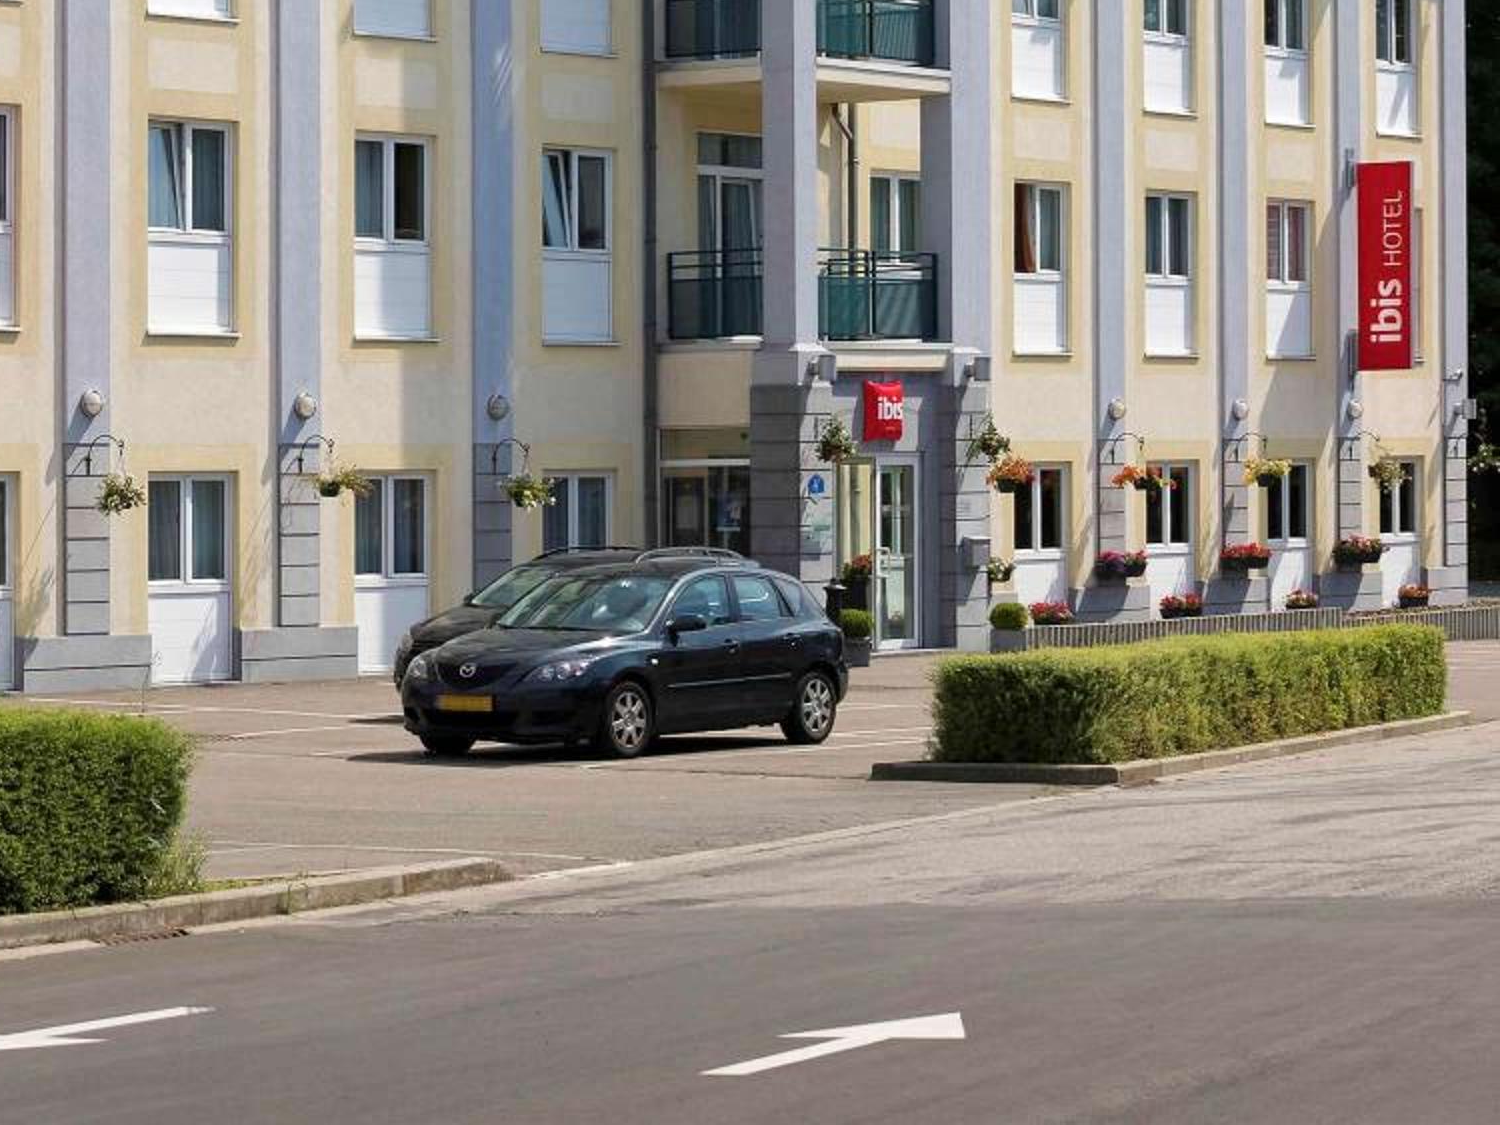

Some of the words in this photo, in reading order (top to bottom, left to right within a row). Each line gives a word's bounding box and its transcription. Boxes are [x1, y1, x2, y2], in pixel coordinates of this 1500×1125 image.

[1383, 190, 1402, 266] HOTEL
[1371, 278, 1402, 343] ibis
[878, 396, 904, 420] ibis
